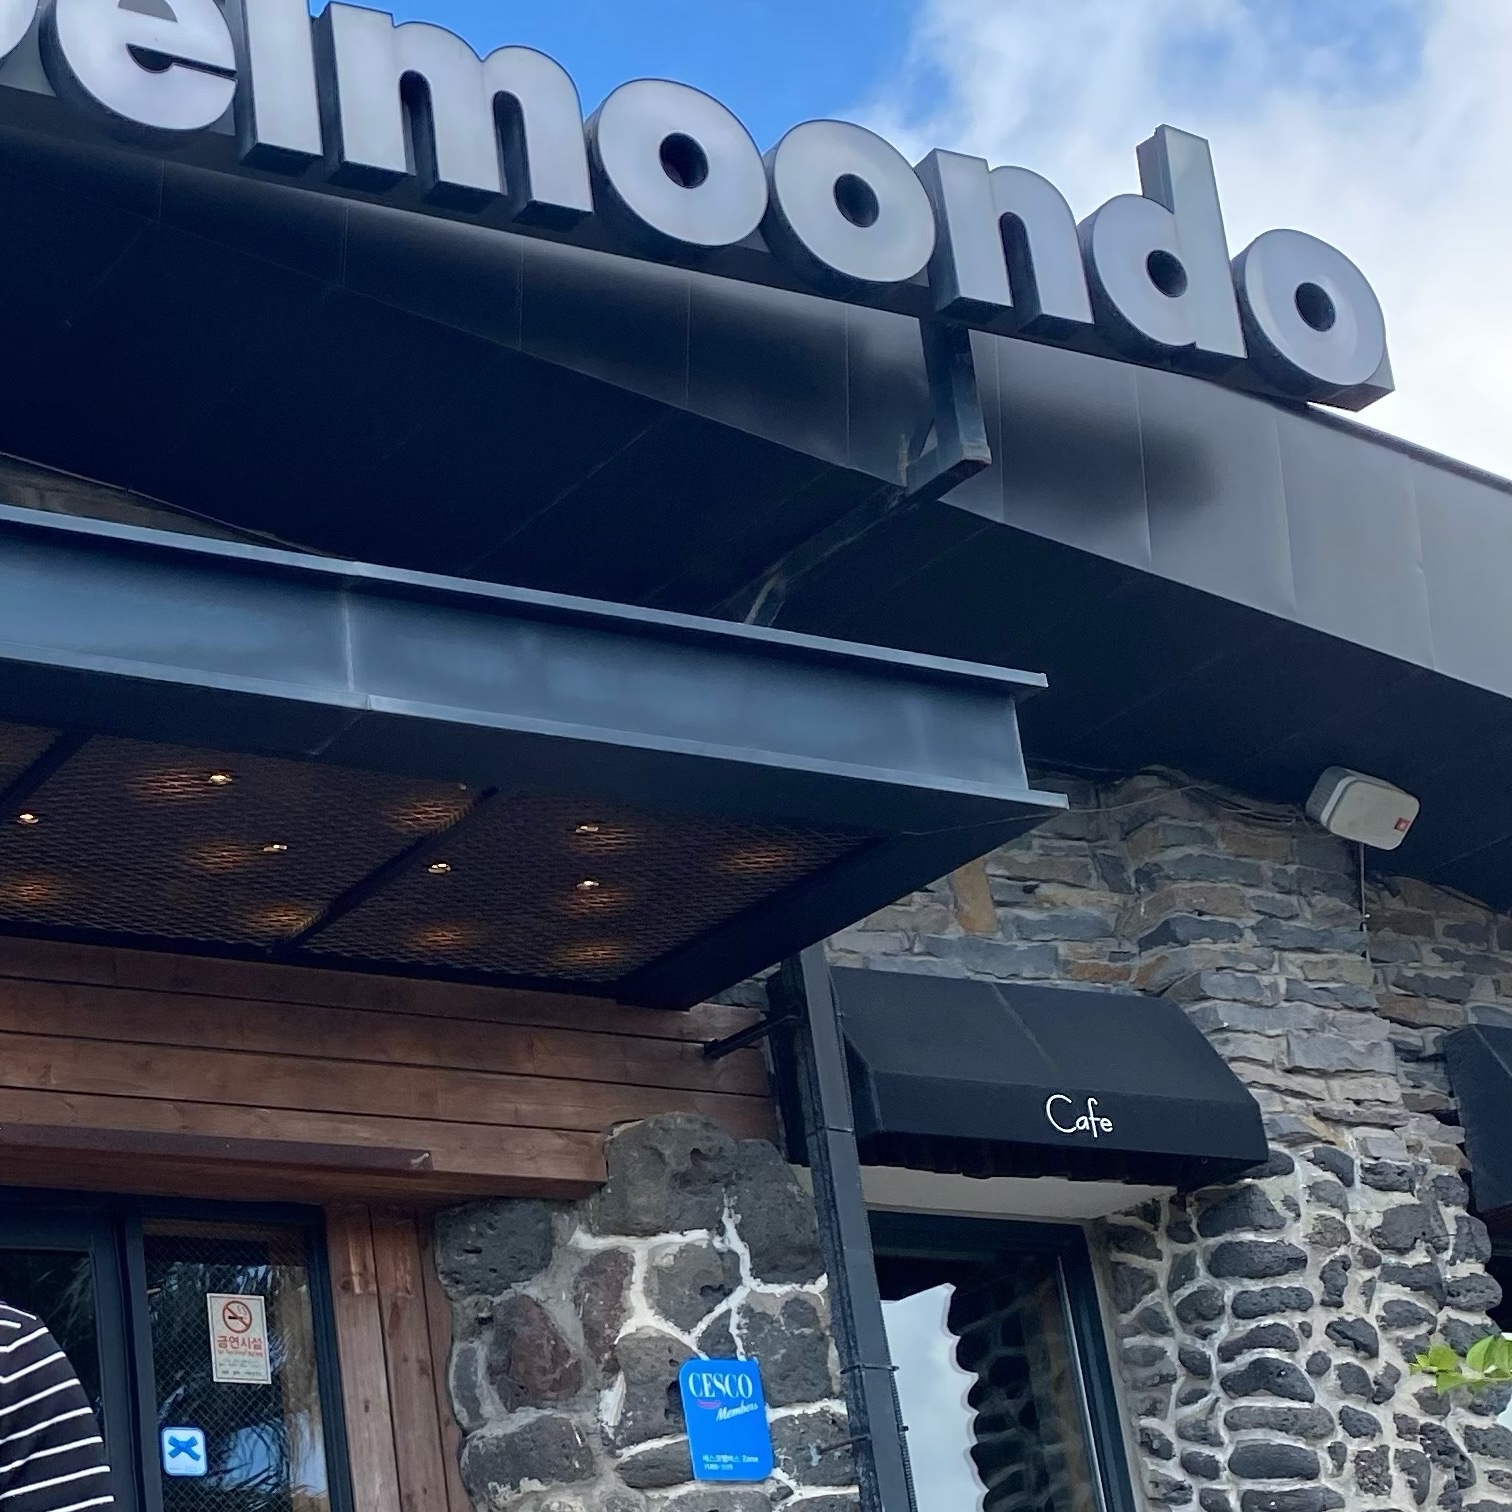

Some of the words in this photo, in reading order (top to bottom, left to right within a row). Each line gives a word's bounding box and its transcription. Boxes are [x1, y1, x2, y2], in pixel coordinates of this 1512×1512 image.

[1045, 1093, 1114, 1138] Cafe
[216, 1335, 263, 1350] 금연시설
[688, 1372, 753, 1399] CESCO
